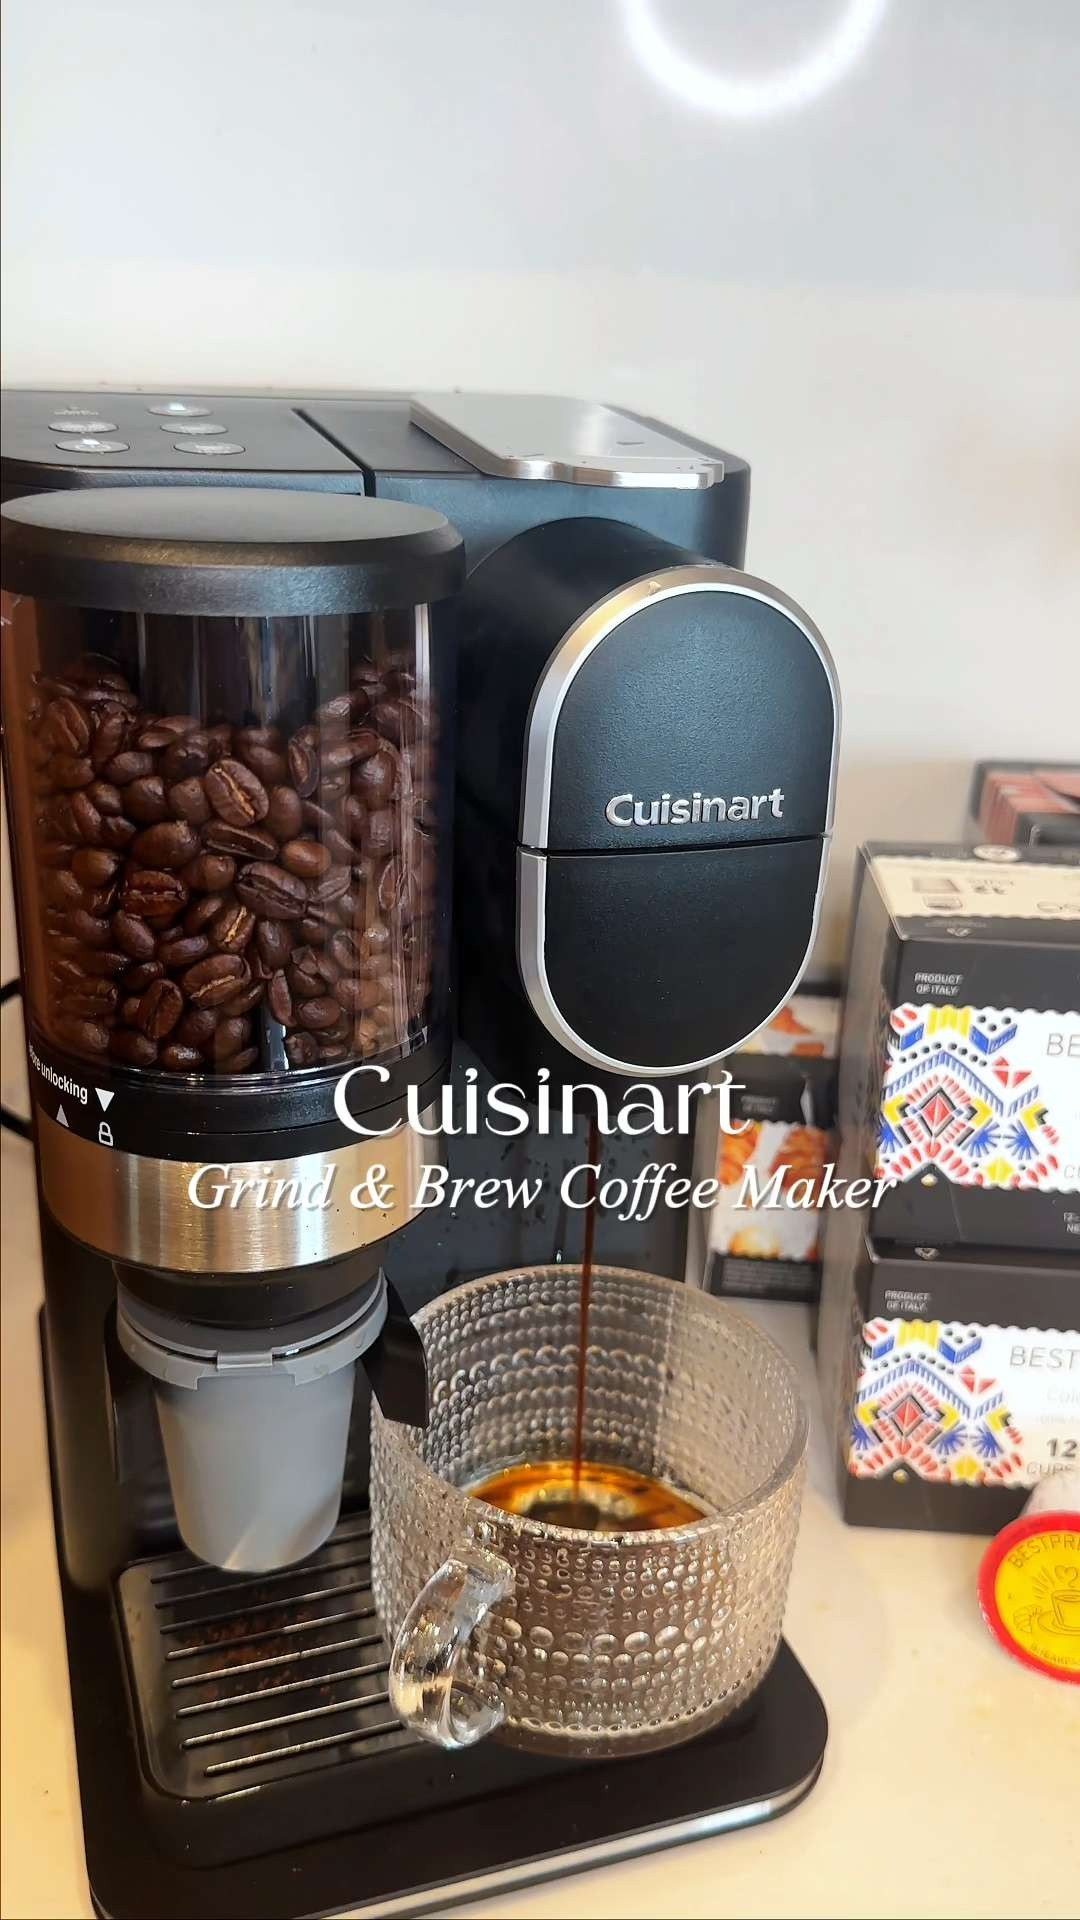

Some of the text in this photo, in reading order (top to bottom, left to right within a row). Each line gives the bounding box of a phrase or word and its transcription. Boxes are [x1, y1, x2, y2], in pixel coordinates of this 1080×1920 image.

[605, 787, 784, 827] Cuisinart
[914, 972, 962, 985] PRODUCT
[916, 983, 959, 996] OF ITALY
[41, 1063, 88, 1105] unlocking
[884, 1290, 931, 1302] PRODUCT
[900, 1302, 928, 1313] ITALY
[1046, 1438, 1078, 1459] 12
